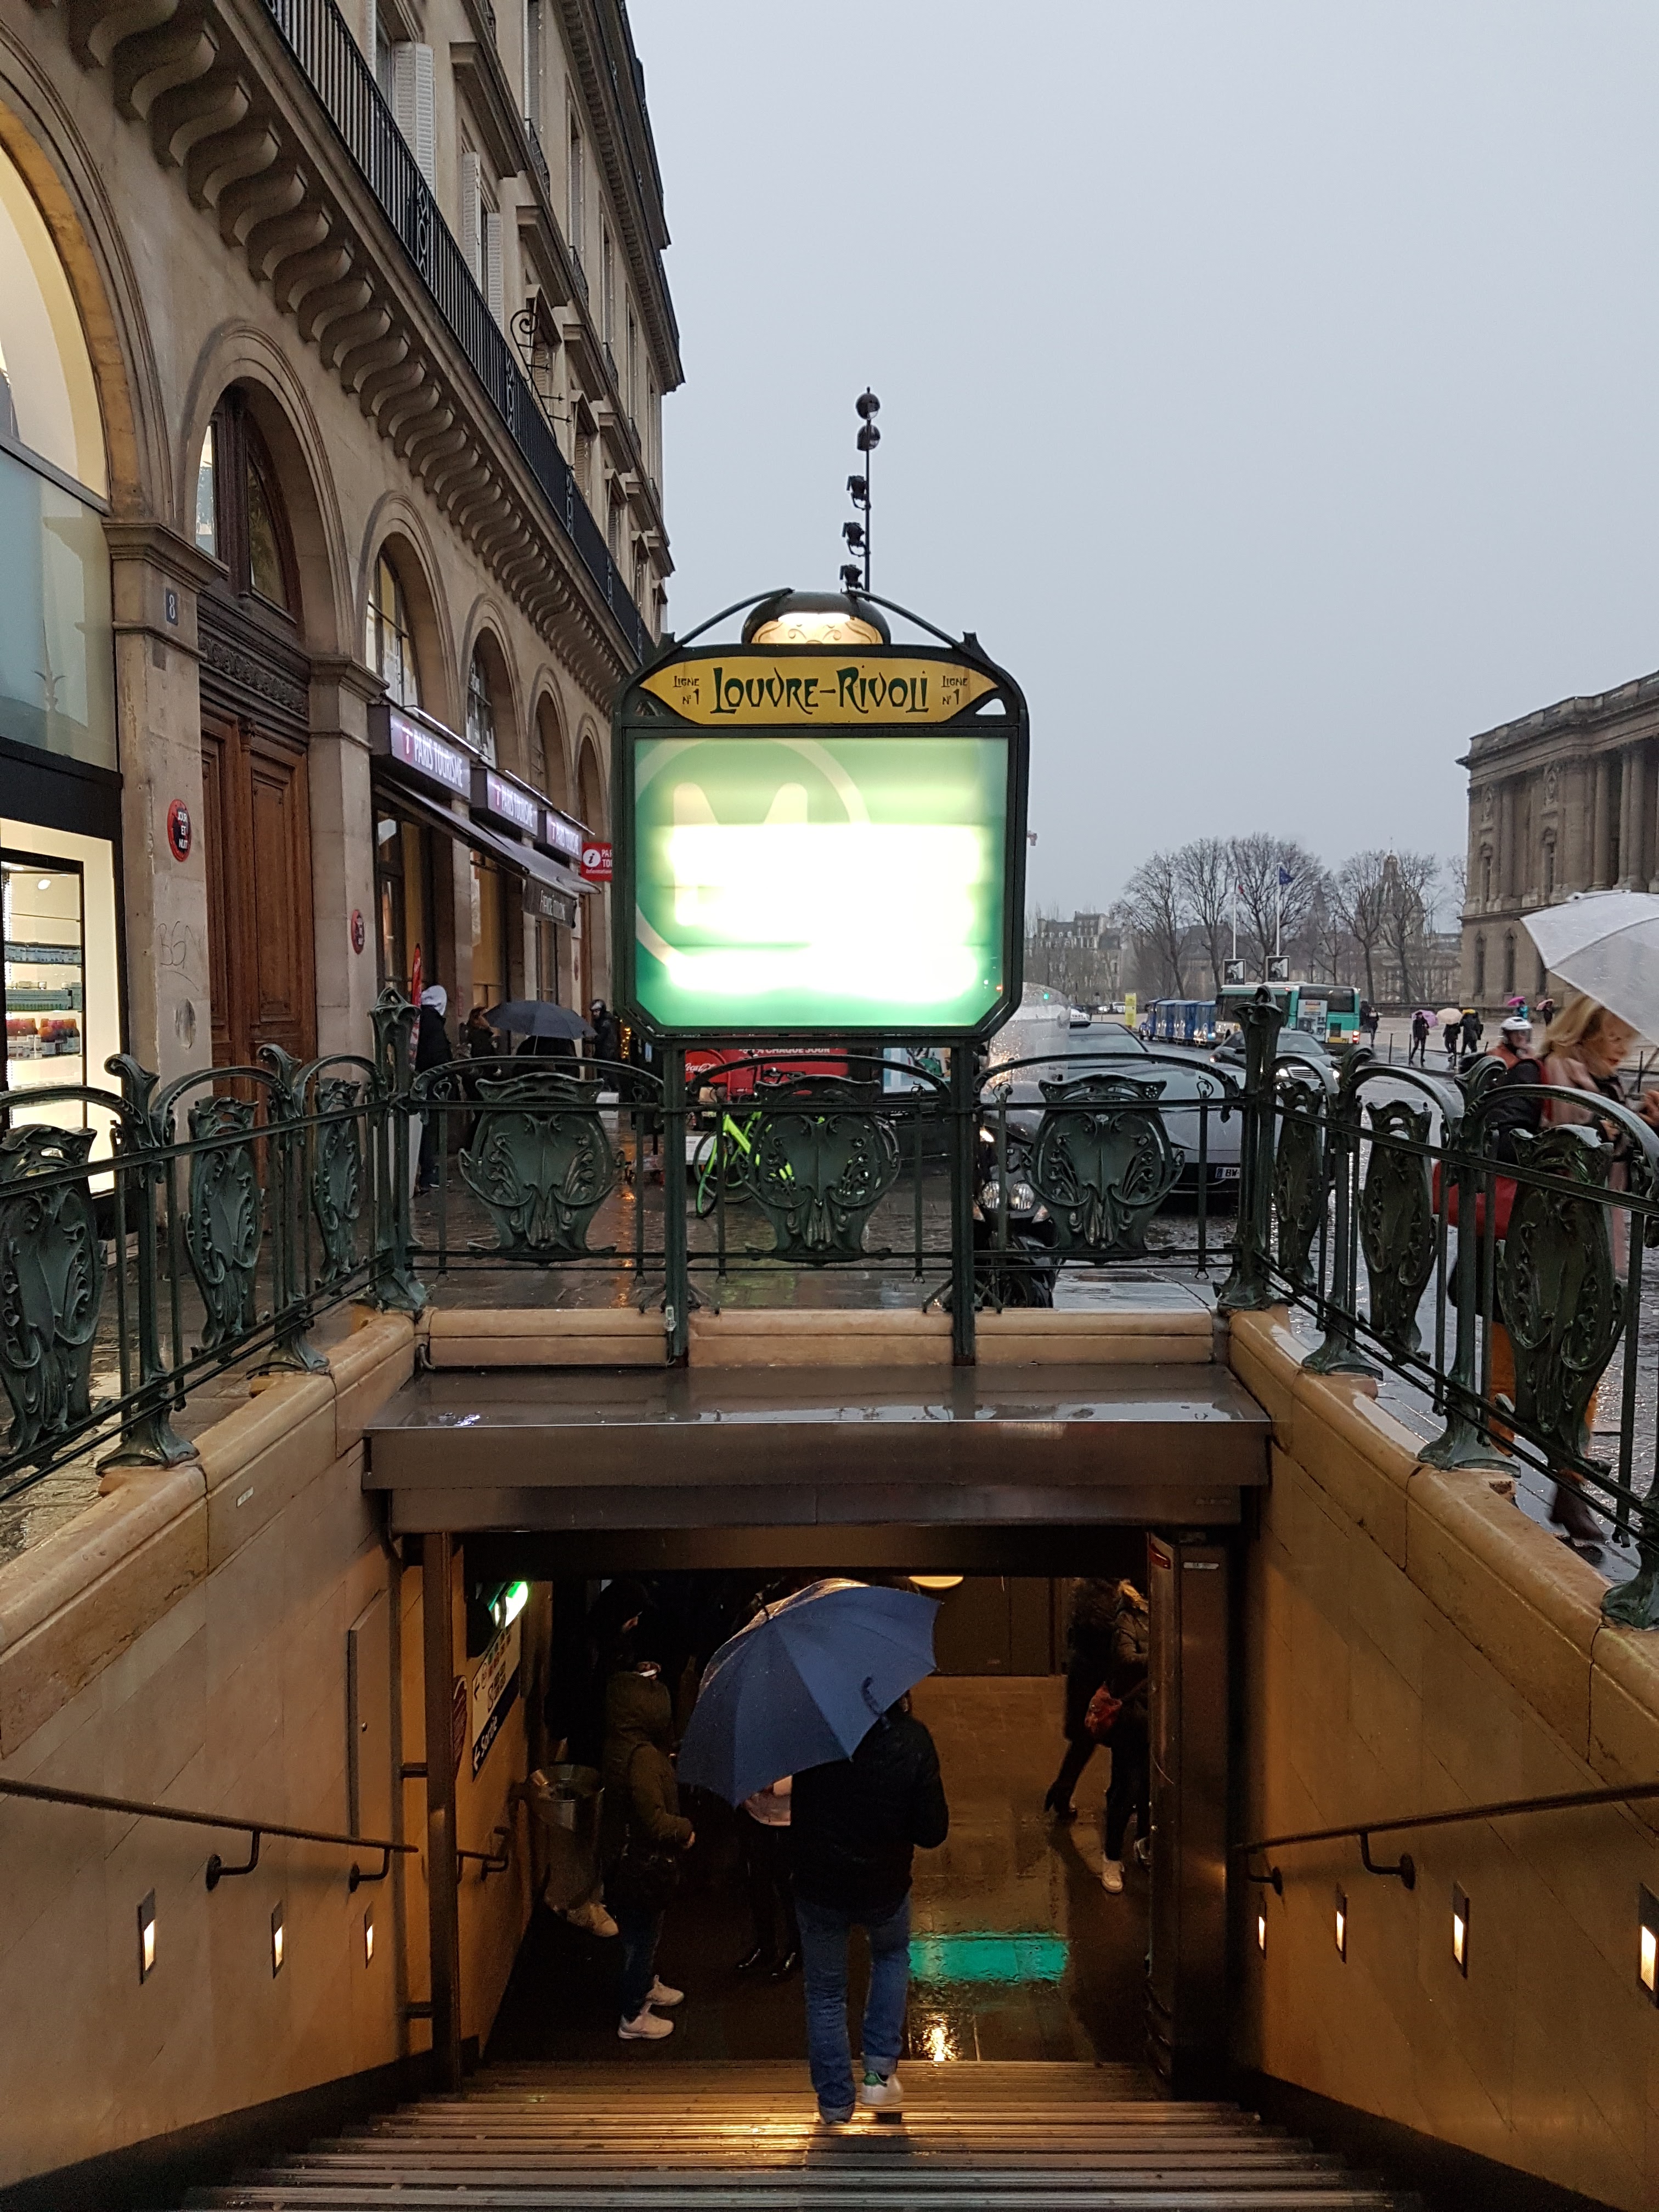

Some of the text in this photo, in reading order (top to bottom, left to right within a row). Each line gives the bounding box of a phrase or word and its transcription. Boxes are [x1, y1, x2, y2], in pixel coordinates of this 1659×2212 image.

[169, 594, 176, 619] 8
[673, 675, 699, 687] LIGNE
[941, 675, 968, 687] LIGNE
[414, 729, 433, 770] PARIS
[433, 742, 462, 788] TOURISME
[177, 811, 188, 823] JOUR
[180, 825, 187, 836] ET
[178, 838, 188, 849] NUIT
